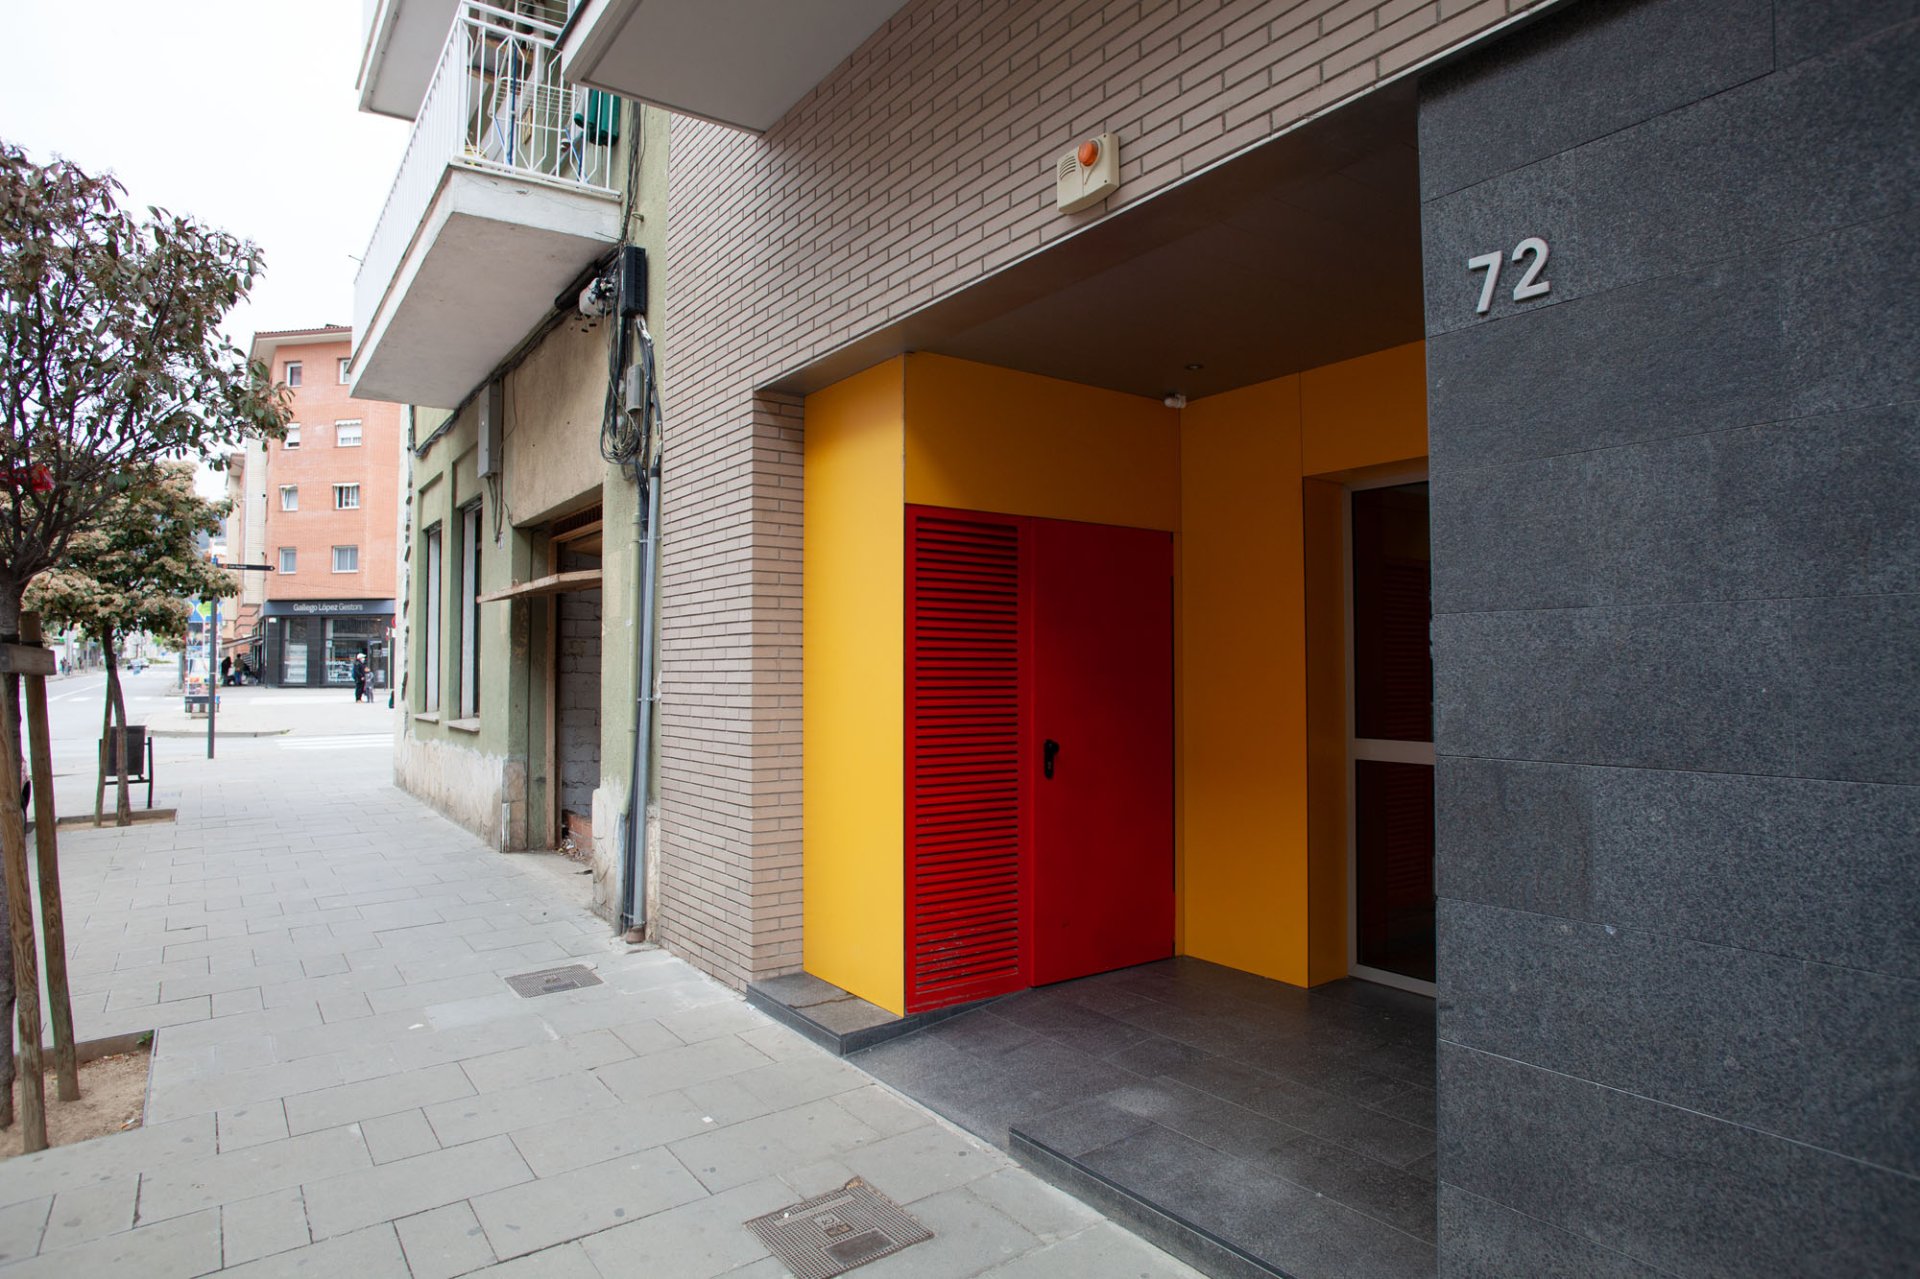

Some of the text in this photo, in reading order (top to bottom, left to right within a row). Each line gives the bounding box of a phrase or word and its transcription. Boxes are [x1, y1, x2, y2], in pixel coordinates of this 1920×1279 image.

[1468, 237, 1551, 314] 72
[293, 602, 364, 613] Gallego López Gestors
